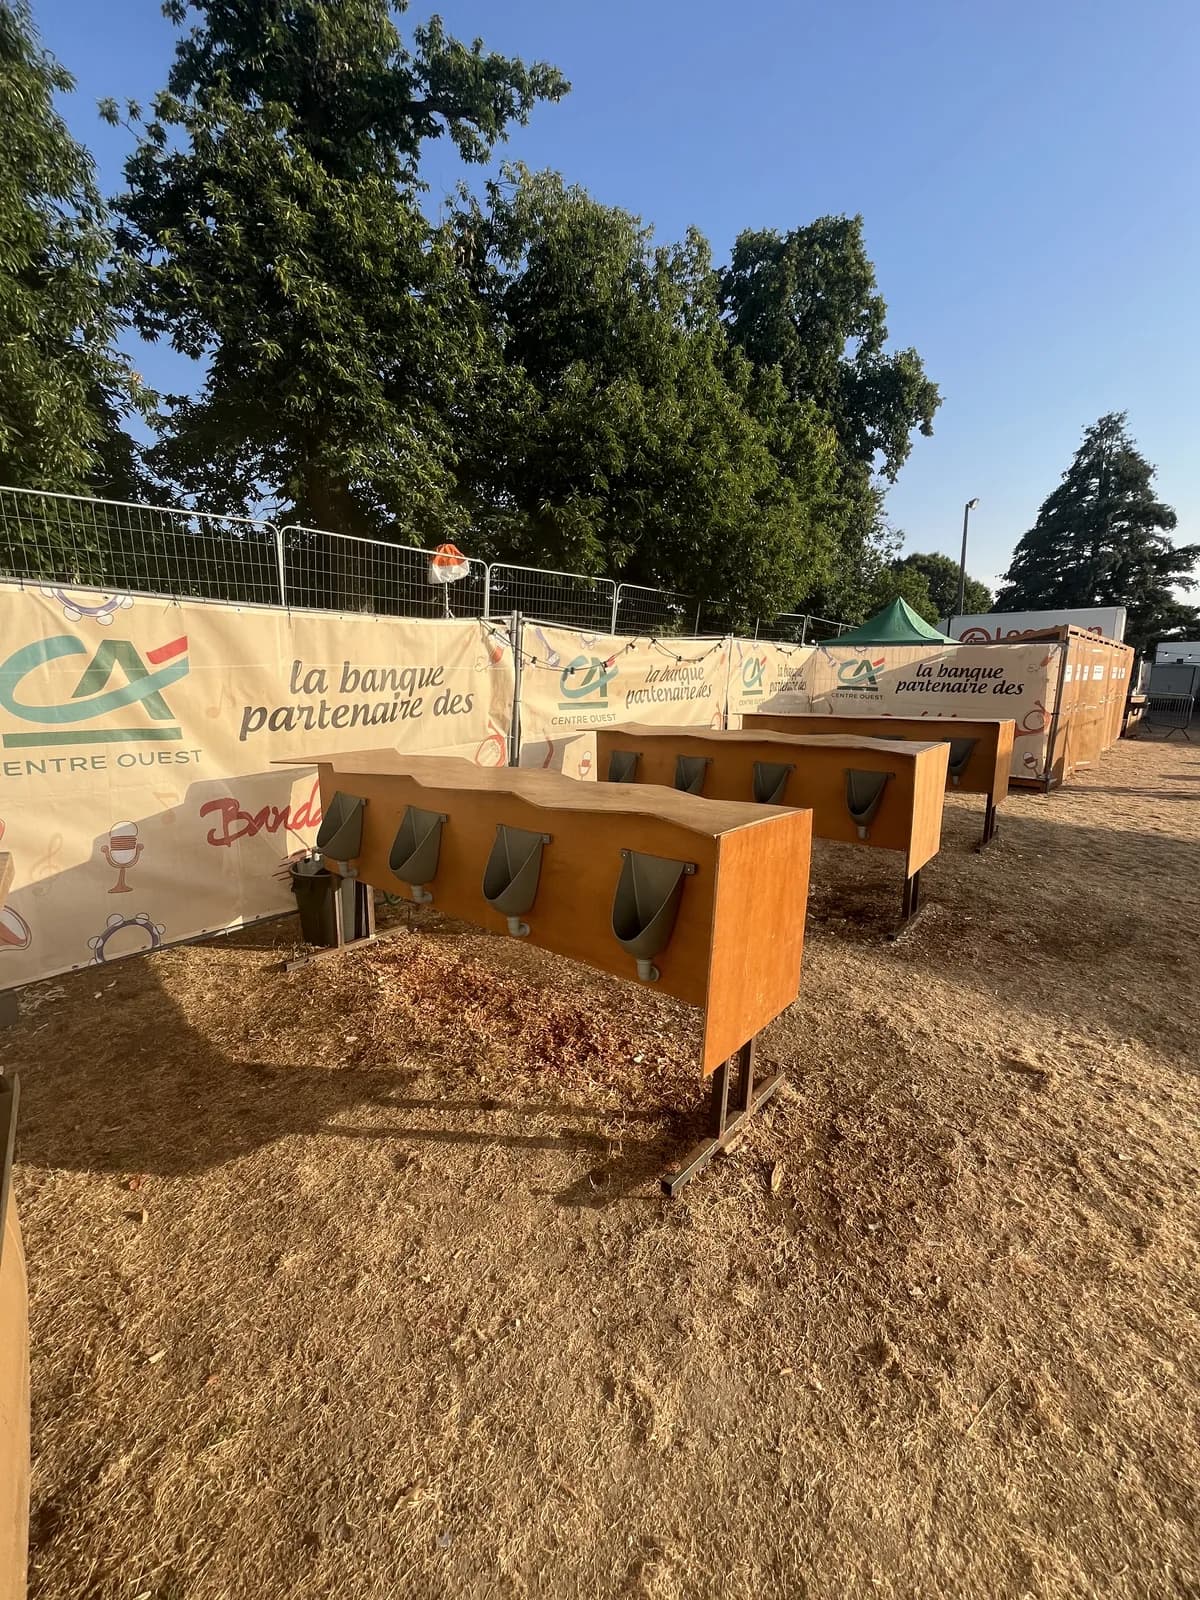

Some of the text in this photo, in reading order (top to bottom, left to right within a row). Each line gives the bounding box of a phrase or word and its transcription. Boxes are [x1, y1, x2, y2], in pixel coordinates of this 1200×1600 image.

[290, 659, 444, 697] la banque
[916, 664, 1004, 681] la banque
[625, 681, 697, 709] partenaire
[831, 692, 859, 700] CENTRE
[895, 679, 1025, 696] partenaire des
[239, 688, 475, 742] partenaire des
[551, 714, 617, 726] CENTRE OUEST
[0, 750, 203, 777] ENTRE OUEST
